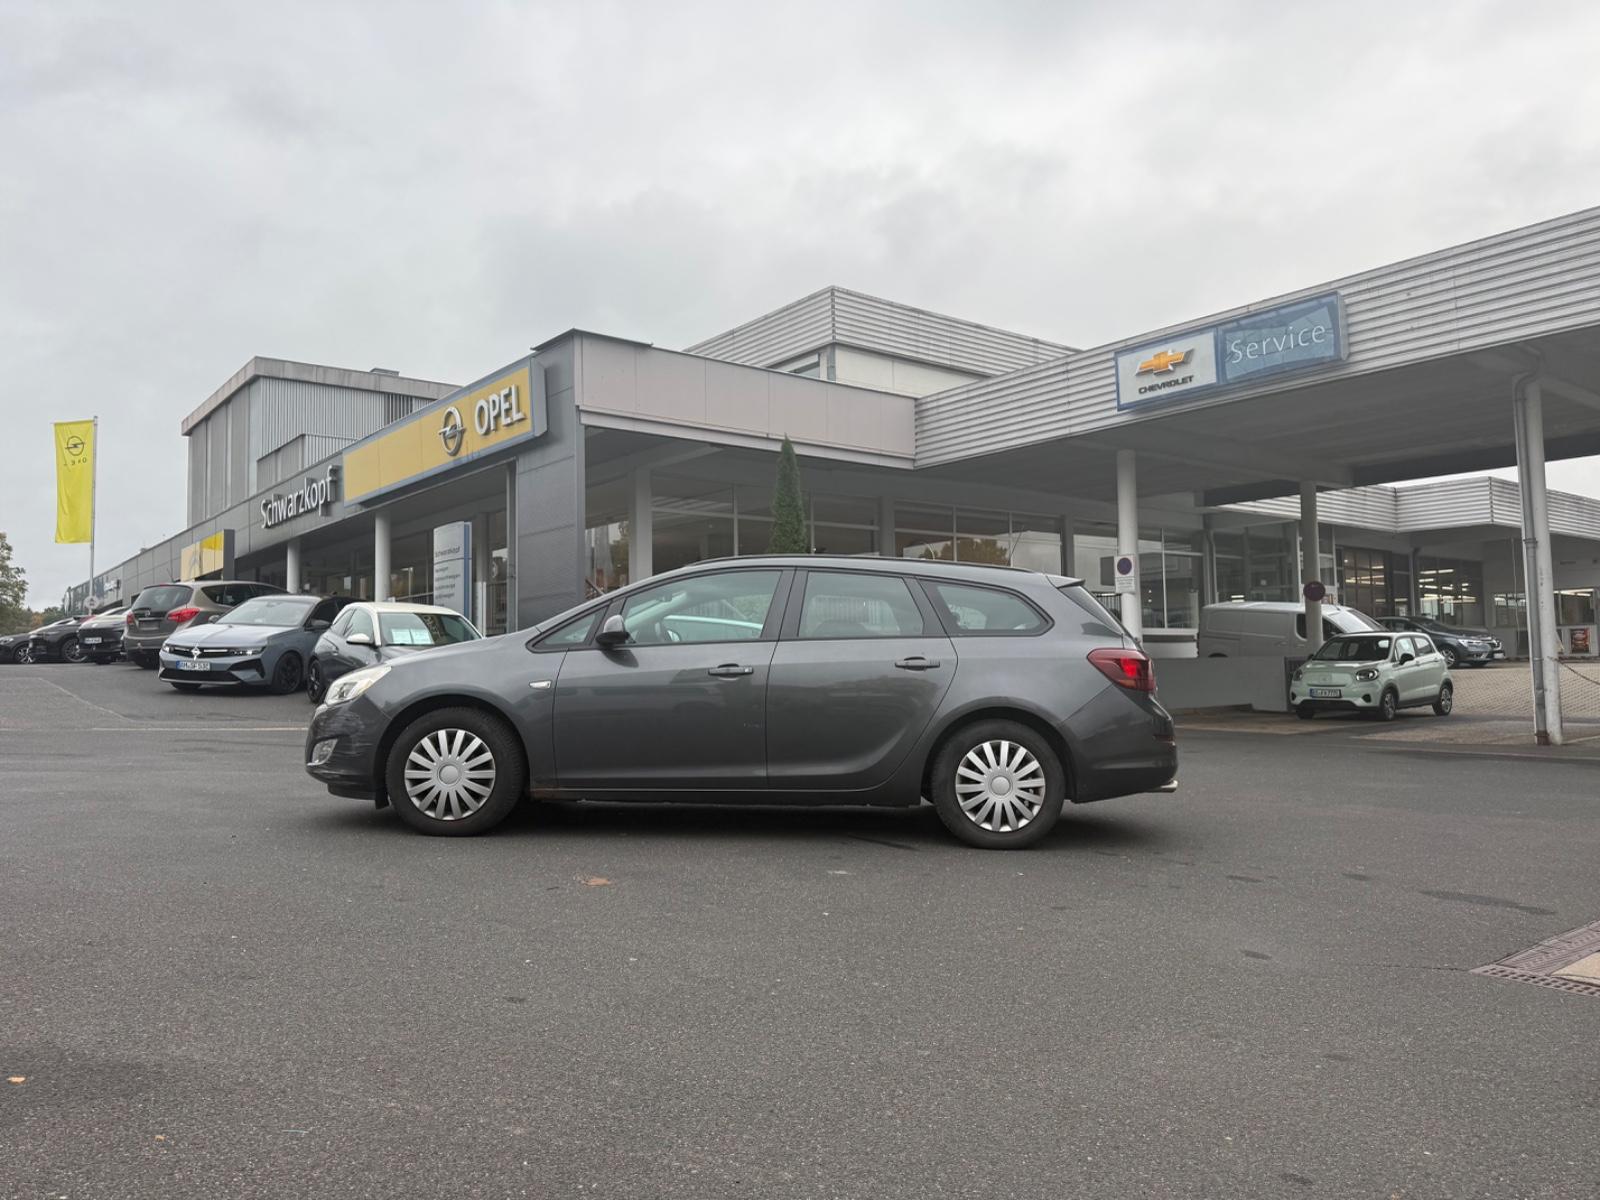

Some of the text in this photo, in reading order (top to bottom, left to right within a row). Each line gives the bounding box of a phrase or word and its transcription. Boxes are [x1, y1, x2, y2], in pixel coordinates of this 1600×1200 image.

[1230, 325, 1325, 363] Service
[1138, 376, 1194, 395] CHEVROLET
[474, 384, 525, 436] OPEL
[260, 466, 335, 530] Schwarzkopf
